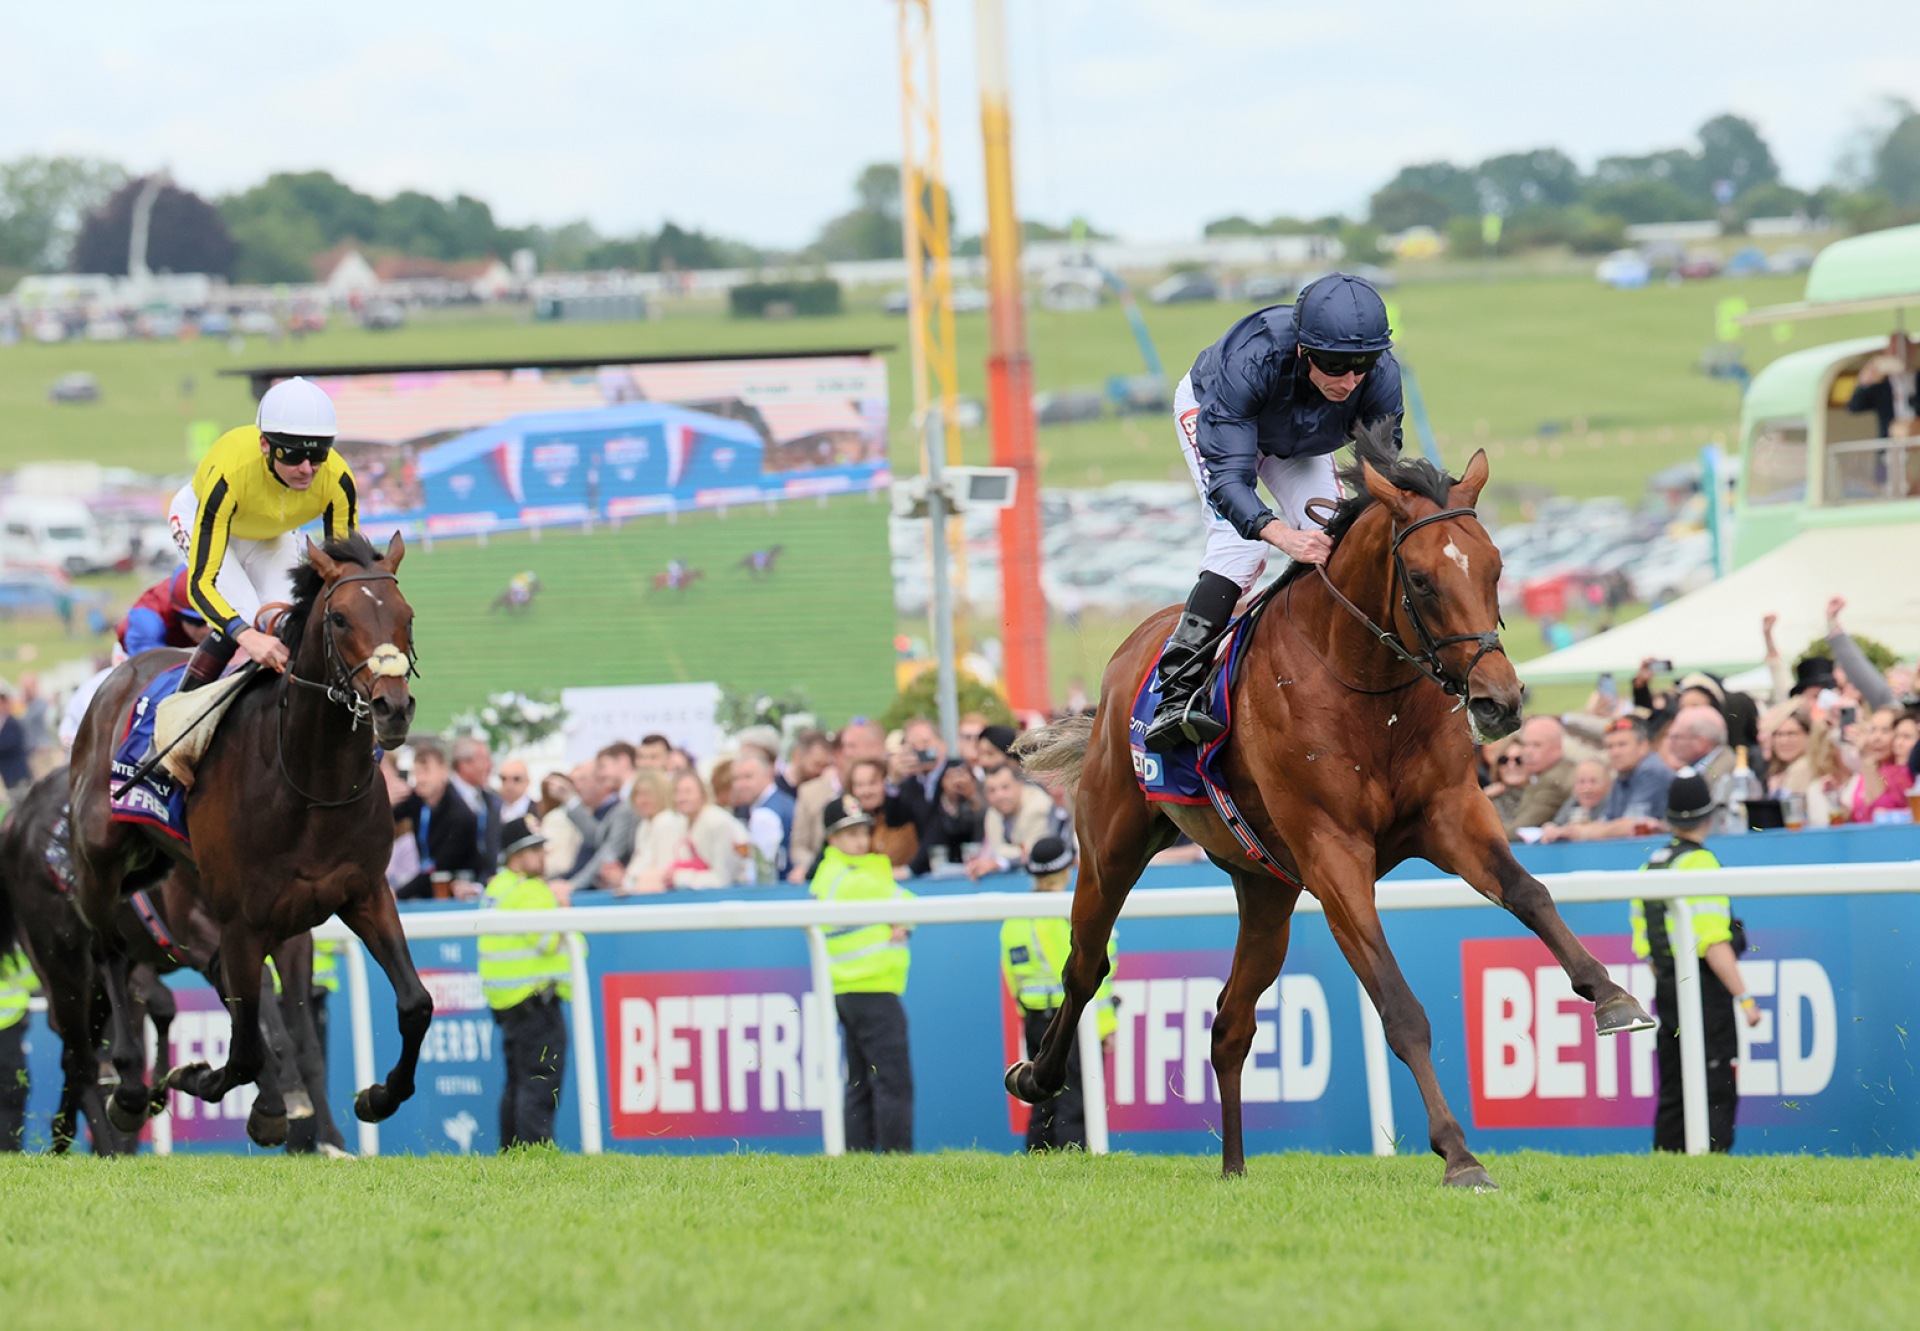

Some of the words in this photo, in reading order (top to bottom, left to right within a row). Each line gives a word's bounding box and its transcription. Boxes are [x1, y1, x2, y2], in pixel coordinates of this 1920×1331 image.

[620, 992, 826, 1113] BETFR
[1112, 973, 1332, 1104] TFRED
[1483, 958, 1838, 1099] BETFED
